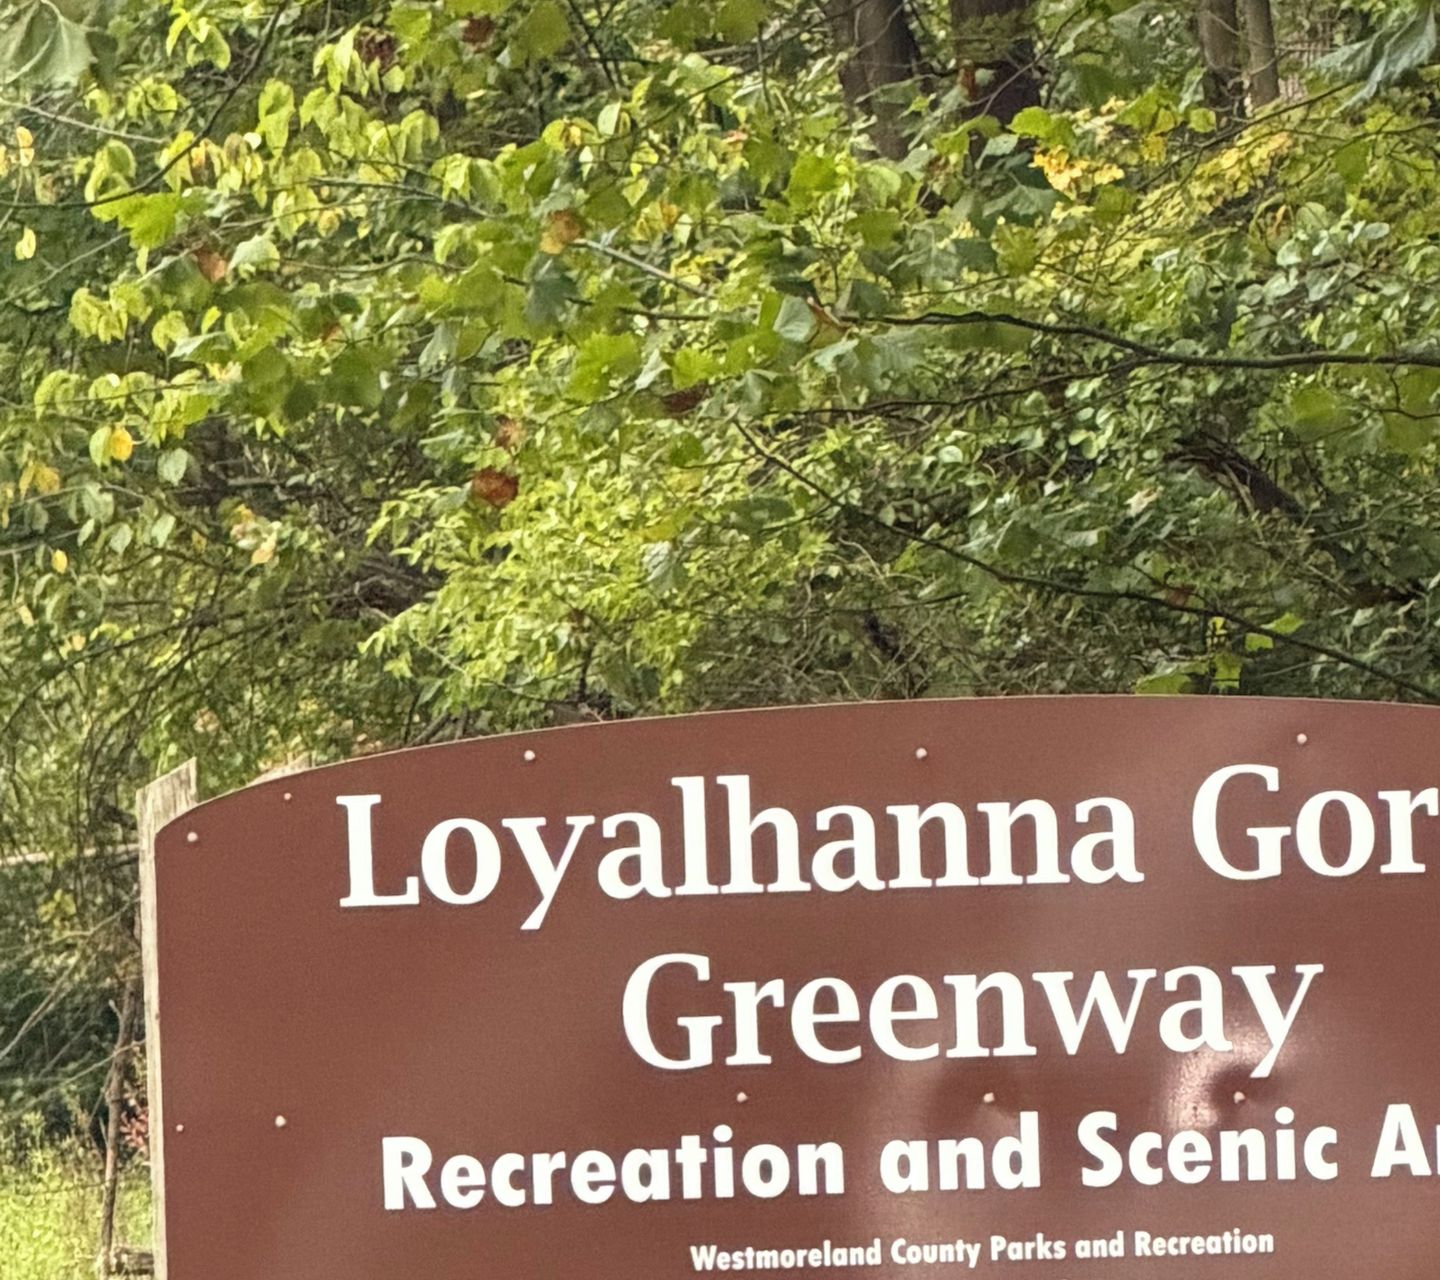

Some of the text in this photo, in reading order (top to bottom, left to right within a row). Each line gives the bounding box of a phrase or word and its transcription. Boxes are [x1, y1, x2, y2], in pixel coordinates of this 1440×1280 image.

[335, 774, 1145, 931] Loyalhanna
[622, 952, 1325, 1079] Greenway
[381, 1123, 845, 1211] Recreation
[879, 1110, 1041, 1194] and
[1077, 1106, 1339, 1188] Scenic
[689, 1227, 1274, 1272] Westmoreland County Parks and Recreation
